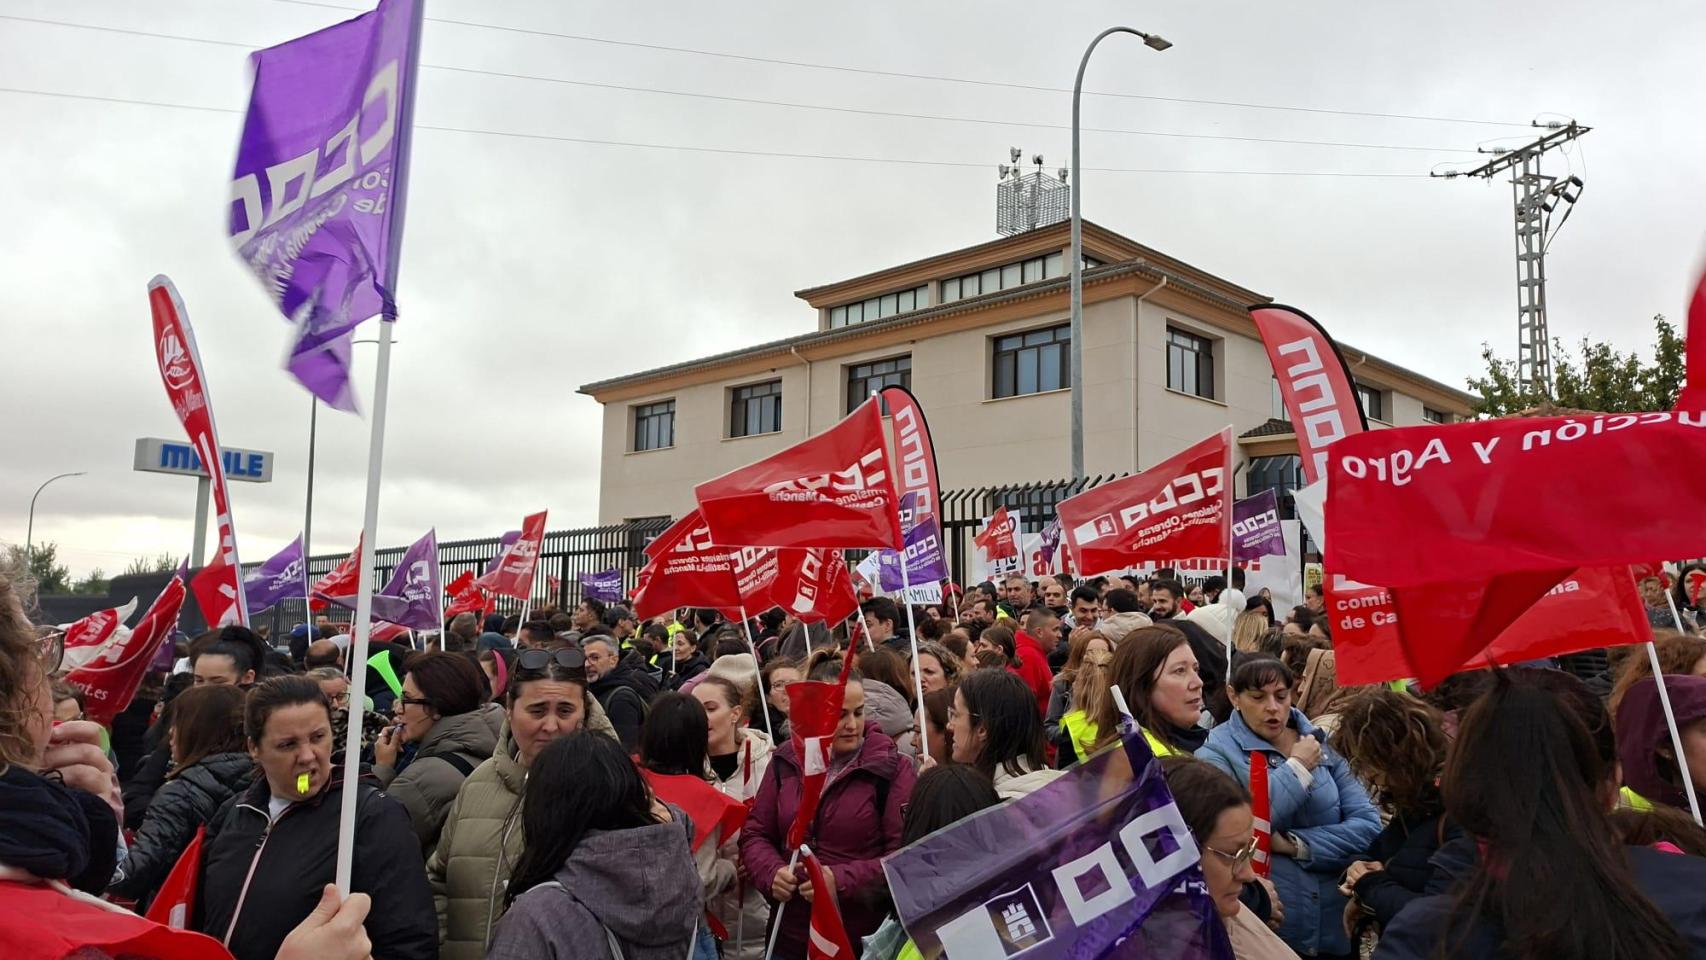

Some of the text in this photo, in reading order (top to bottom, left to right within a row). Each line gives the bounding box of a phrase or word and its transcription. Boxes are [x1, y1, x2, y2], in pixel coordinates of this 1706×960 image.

[1336, 591, 1392, 611] comis
[1340, 610, 1398, 630] de Ca
